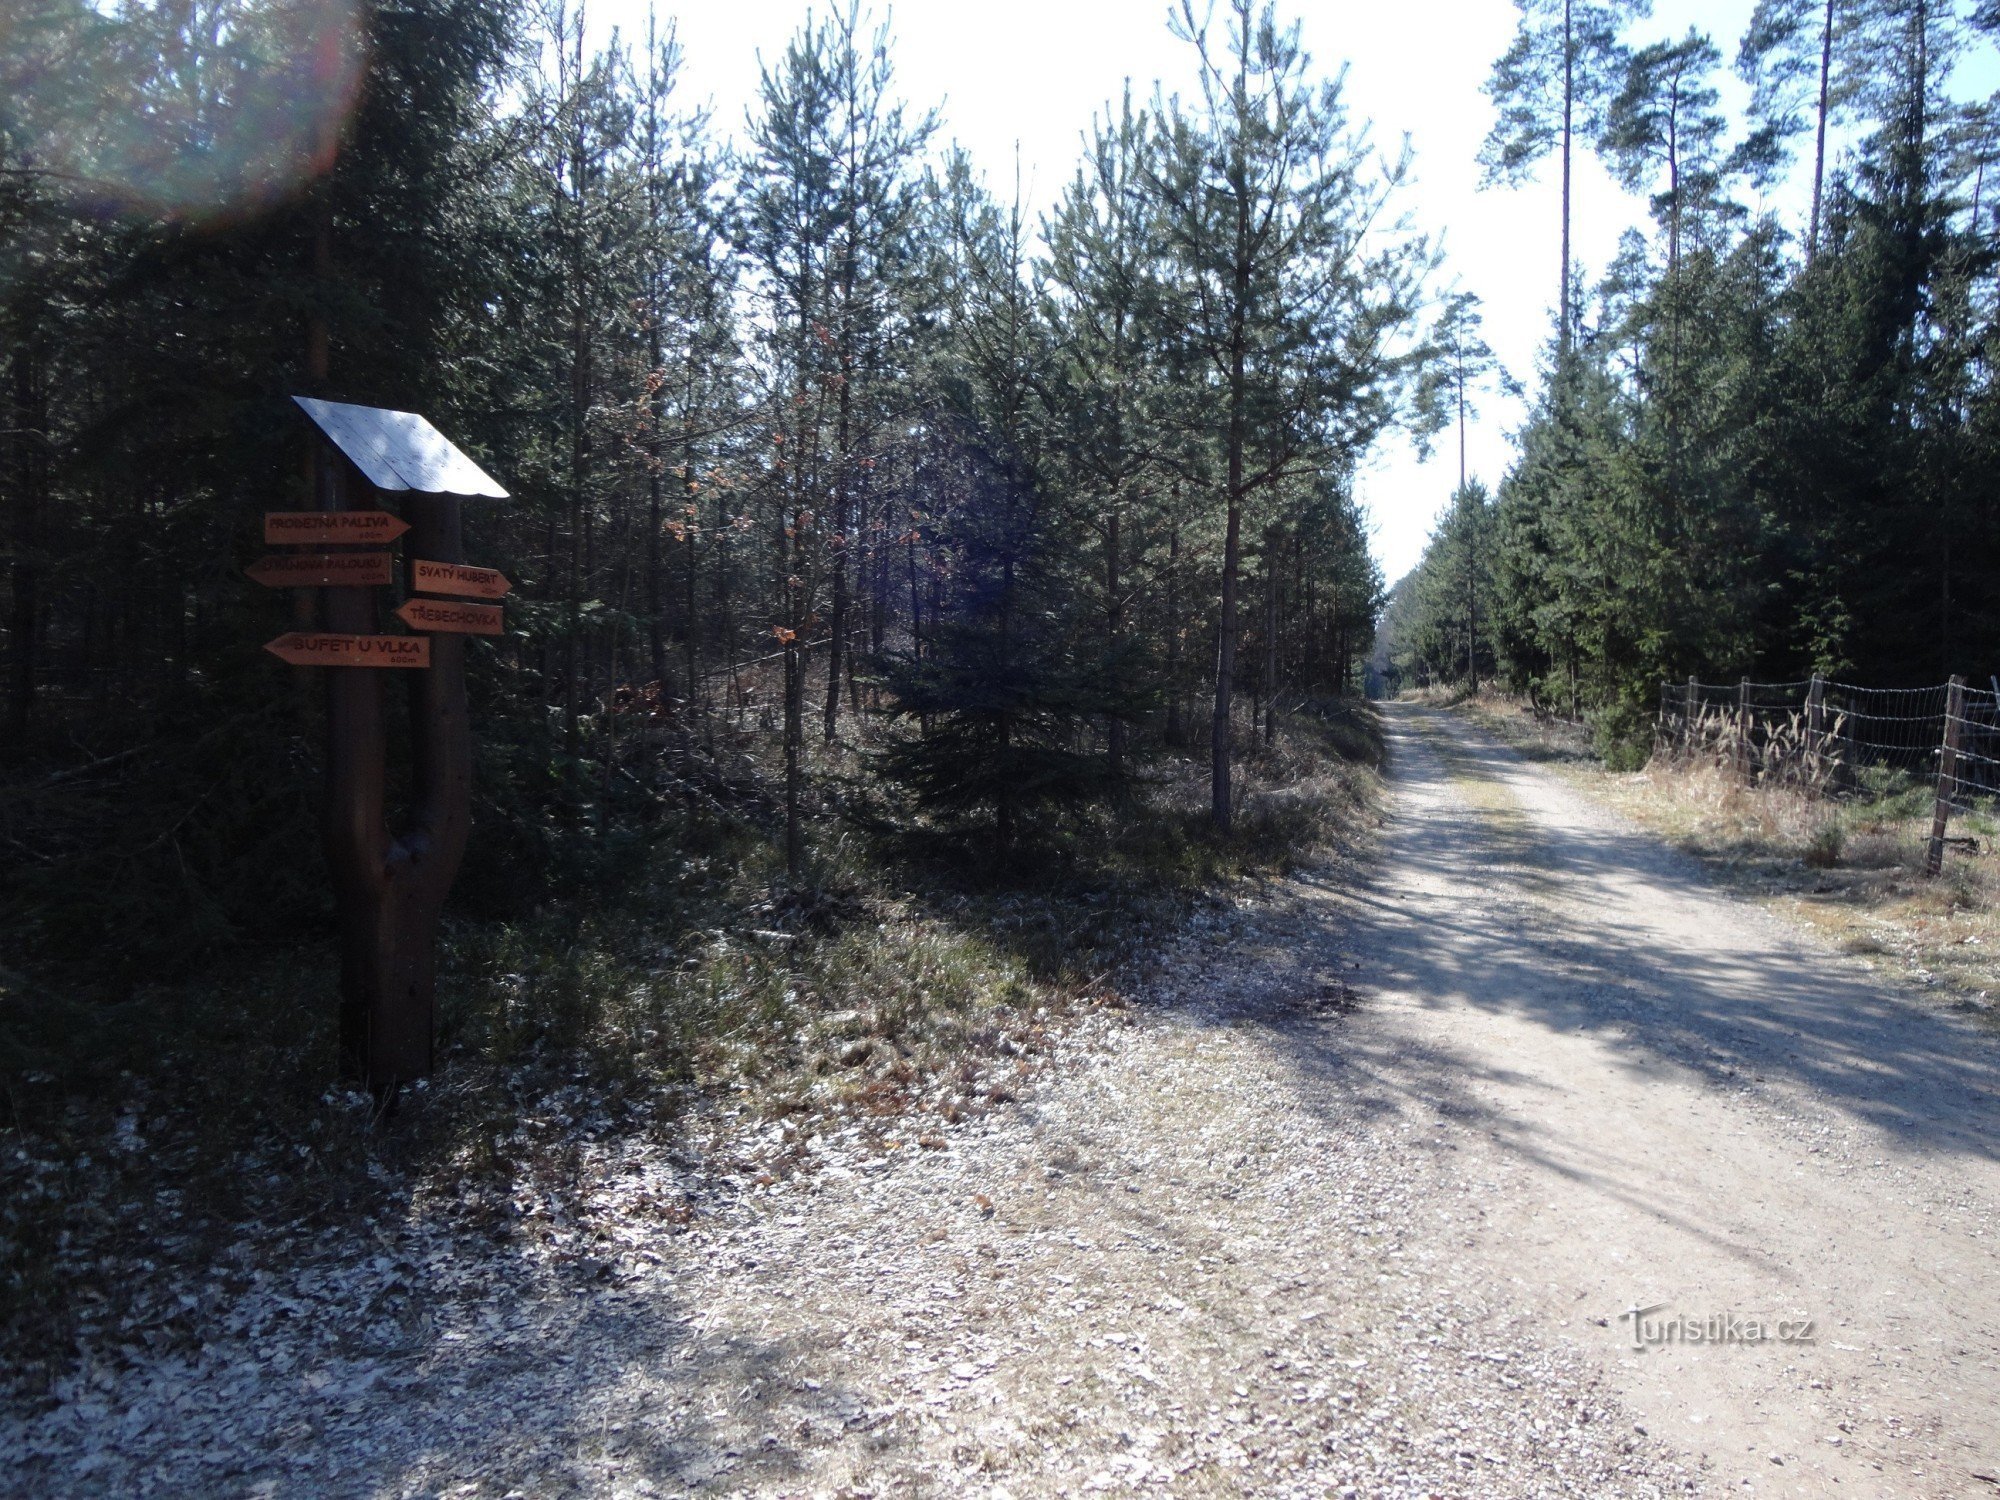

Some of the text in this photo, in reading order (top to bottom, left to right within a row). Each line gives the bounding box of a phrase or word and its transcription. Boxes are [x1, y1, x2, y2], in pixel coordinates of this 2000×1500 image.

[269, 516, 389, 529] PRODEJNA PALIVA
[326, 557, 382, 570] PALOUKU
[419, 564, 498, 585] SVATÝ HUBERT
[410, 604, 498, 626] TŘEBECHOVKA
[293, 638, 421, 654] BUFET U VLKA
